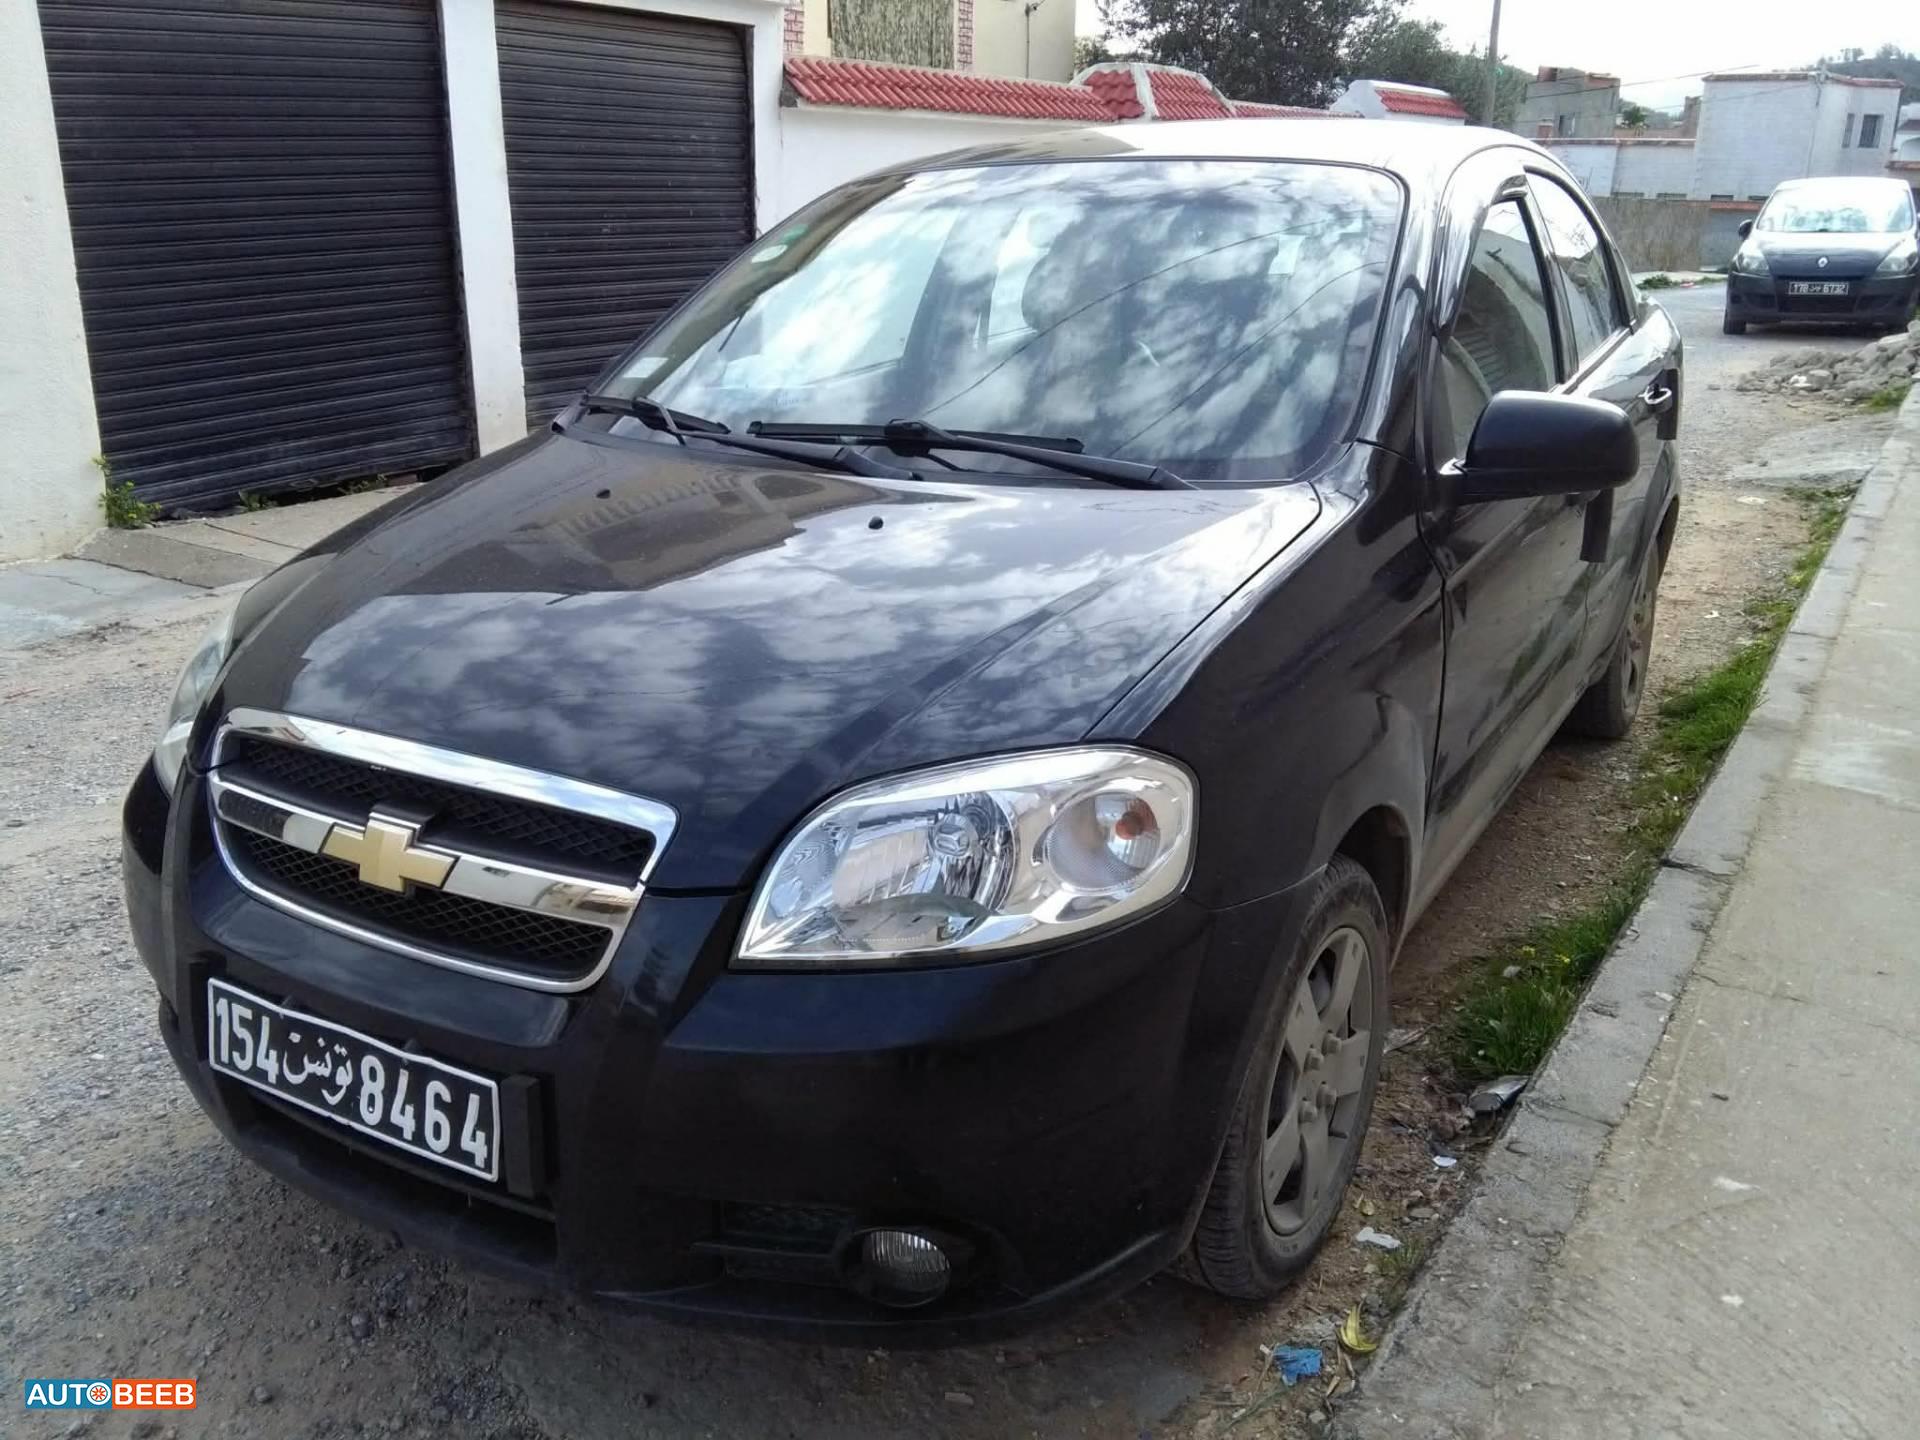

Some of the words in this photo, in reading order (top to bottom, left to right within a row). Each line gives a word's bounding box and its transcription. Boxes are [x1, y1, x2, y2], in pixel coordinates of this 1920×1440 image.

[216, 998, 279, 1084] 154
[283, 1032, 352, 1106] تونس
[359, 1054, 487, 1169] 8464
